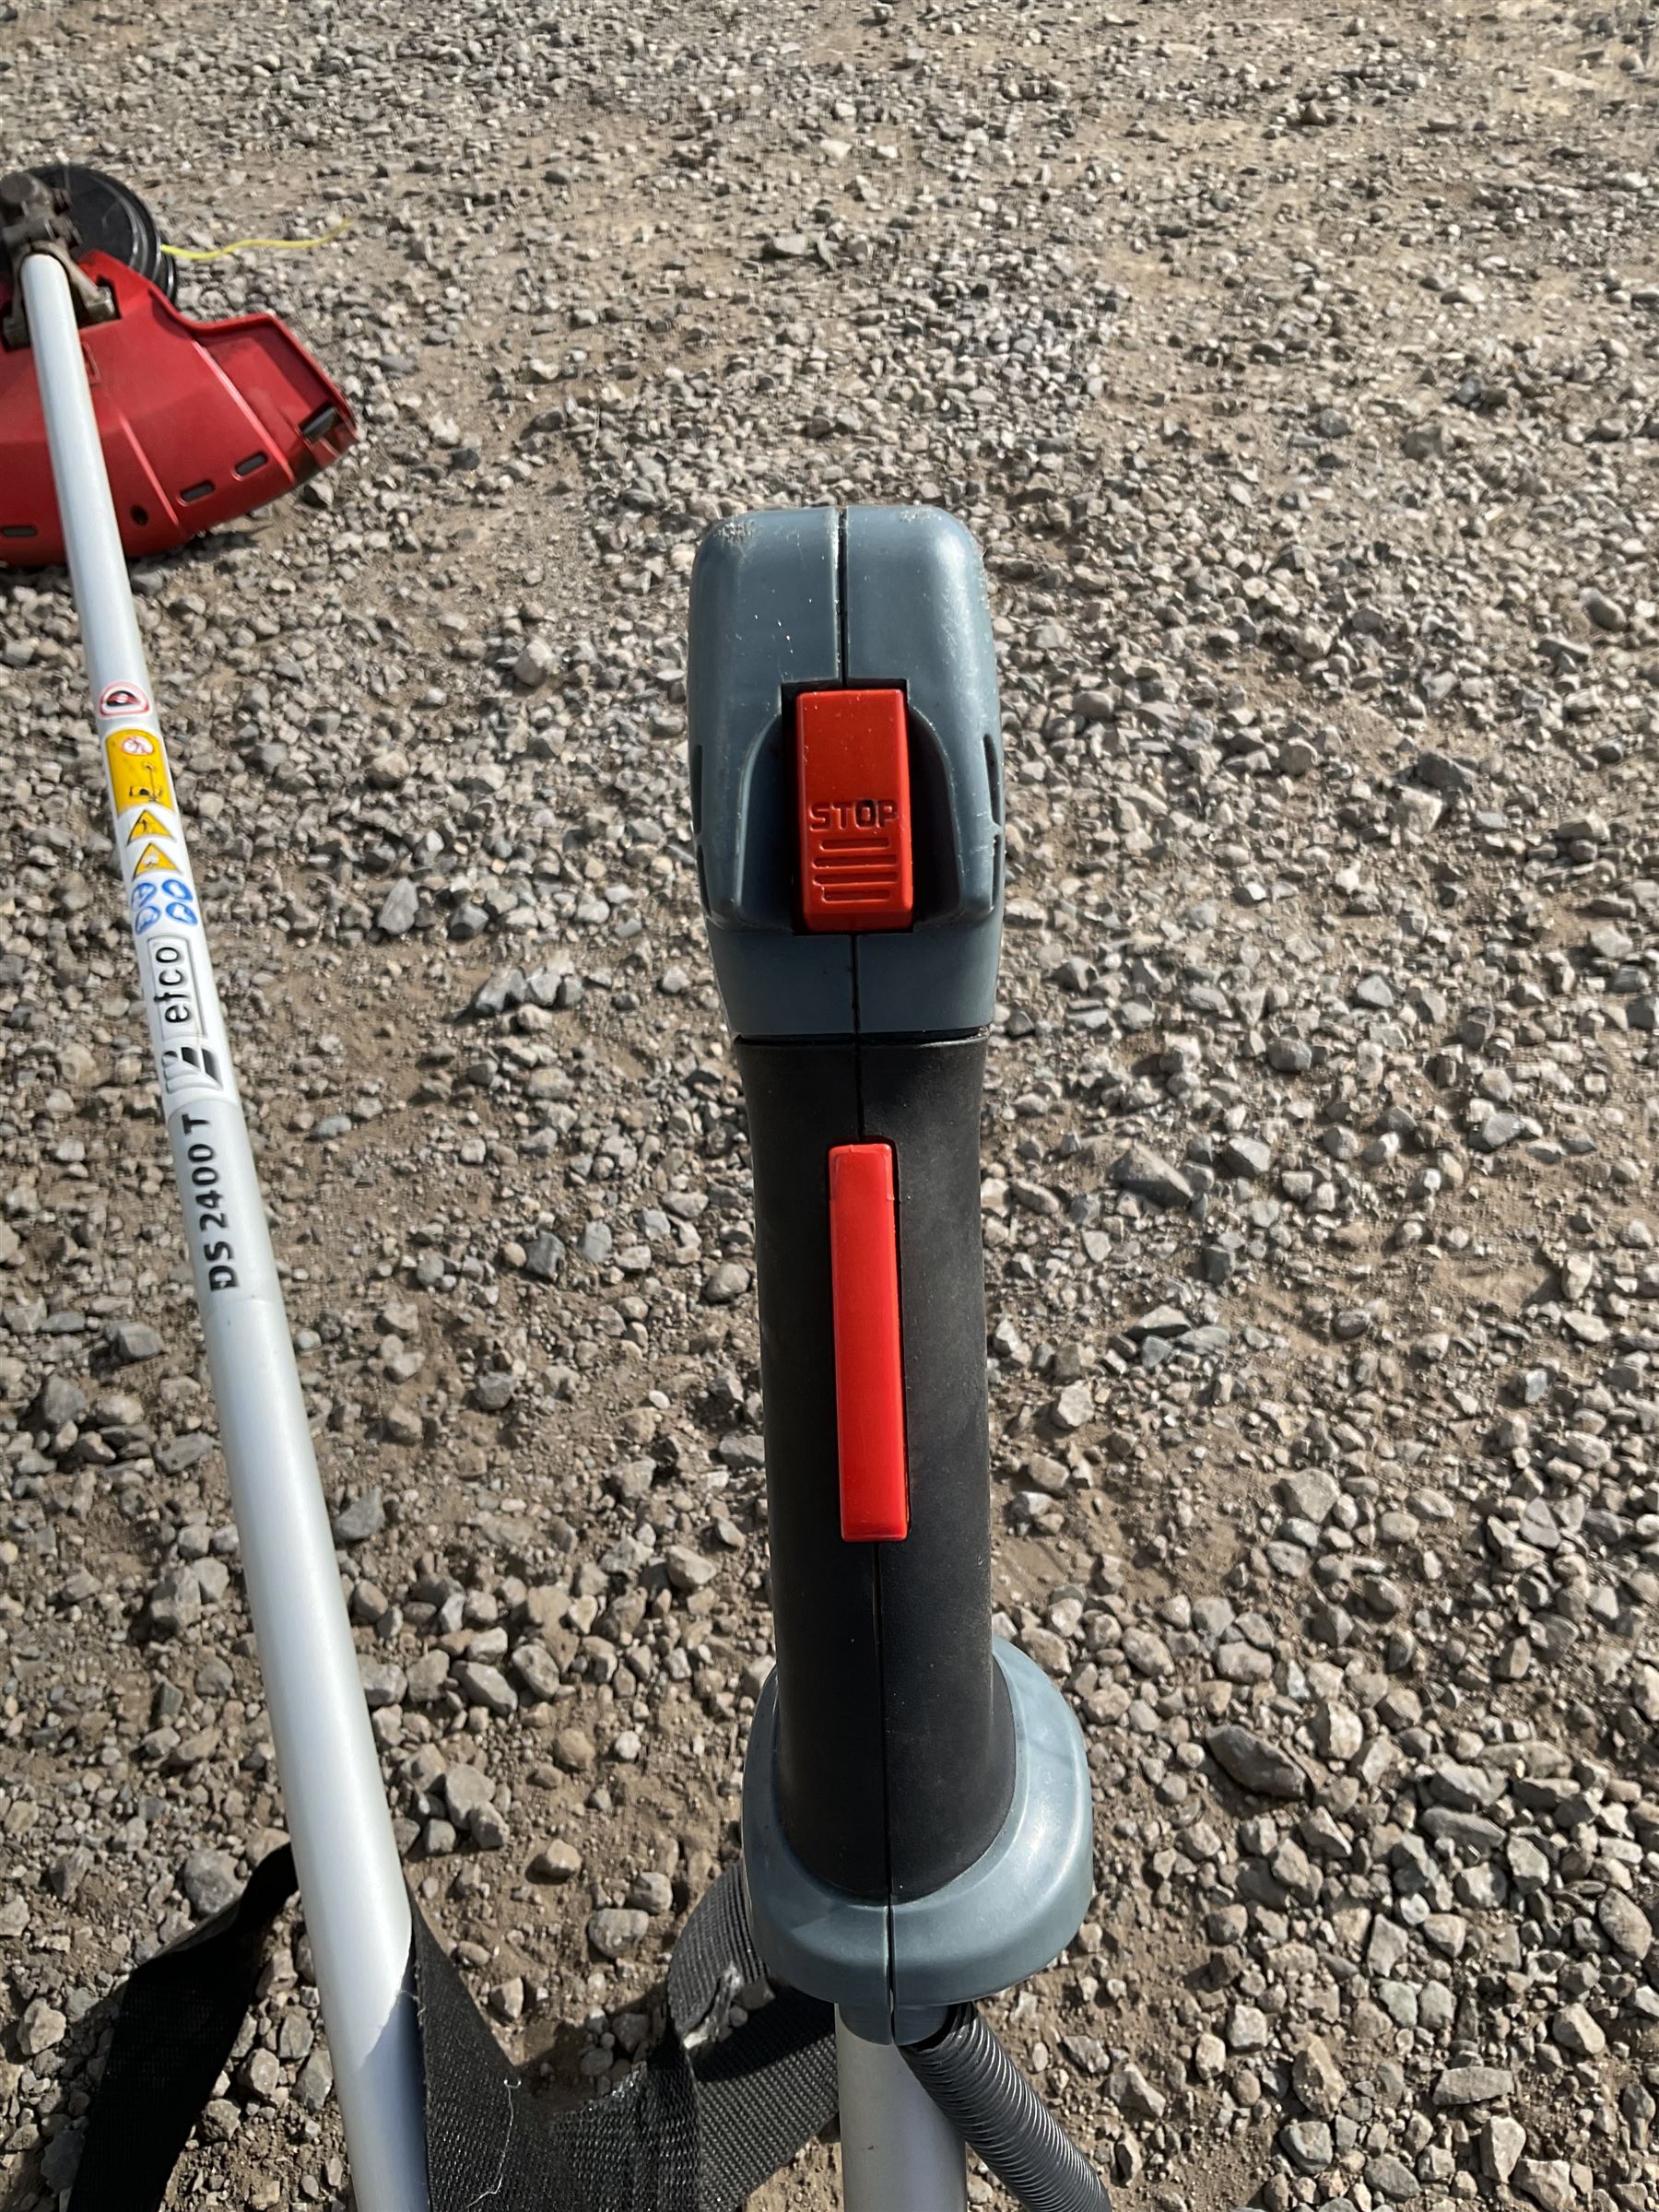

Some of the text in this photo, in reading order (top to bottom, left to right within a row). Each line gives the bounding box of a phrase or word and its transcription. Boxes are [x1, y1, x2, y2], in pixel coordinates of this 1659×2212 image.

[809, 799, 900, 831] STOP
[182, 1113, 239, 1291] DS 2400 T
